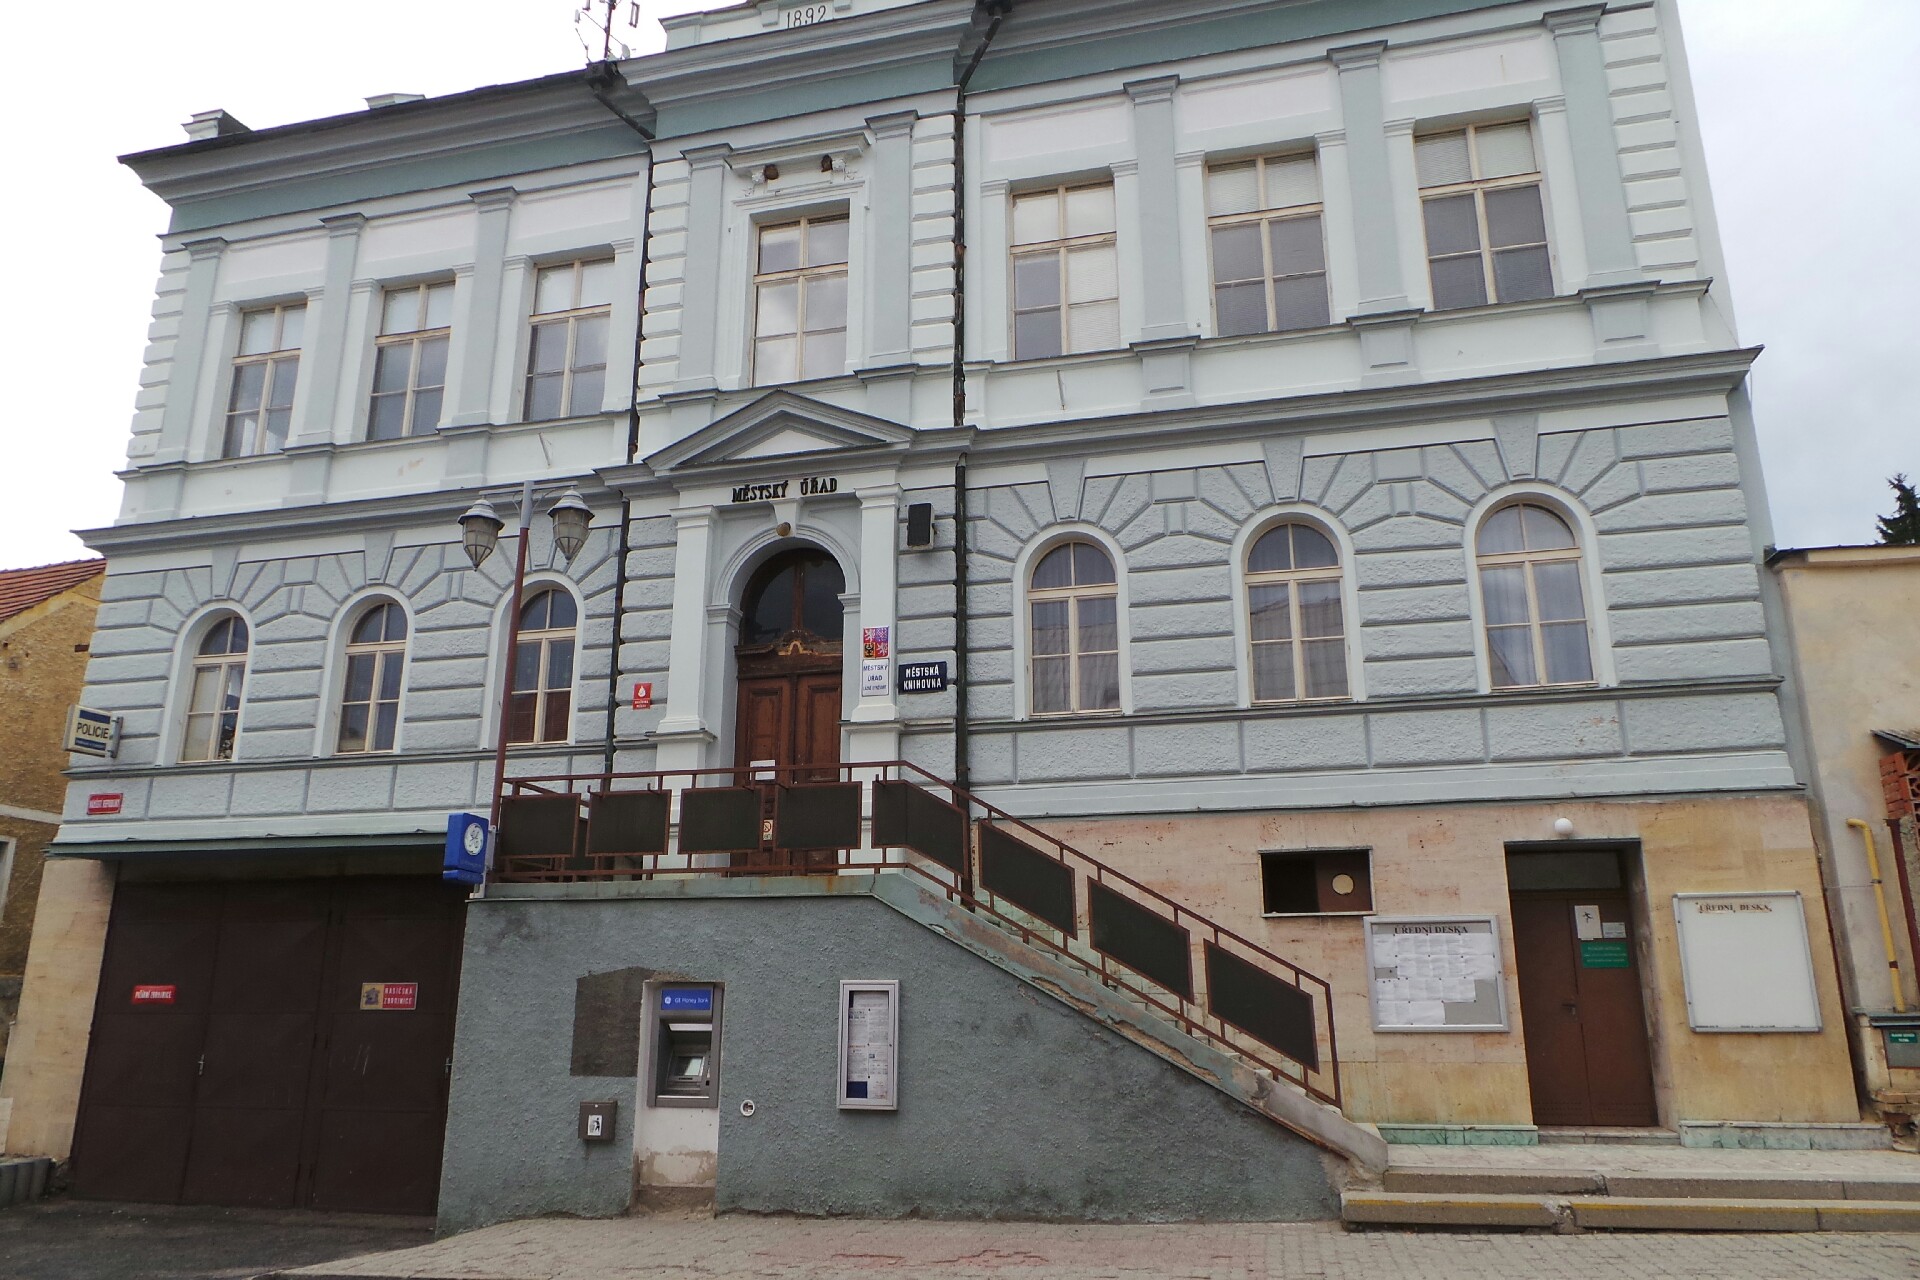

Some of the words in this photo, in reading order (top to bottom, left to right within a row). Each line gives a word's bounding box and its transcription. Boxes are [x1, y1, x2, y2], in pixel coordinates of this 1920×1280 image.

[732, 480, 789, 503] MĚSTSKÝ
[800, 477, 838, 496] ÚŘAD
[905, 664, 940, 678] MĚSTSKÁ
[902, 678, 942, 691] KNIHOVNA
[76, 723, 110, 739] POLICIE
[1435, 926, 1468, 934] DESKA
